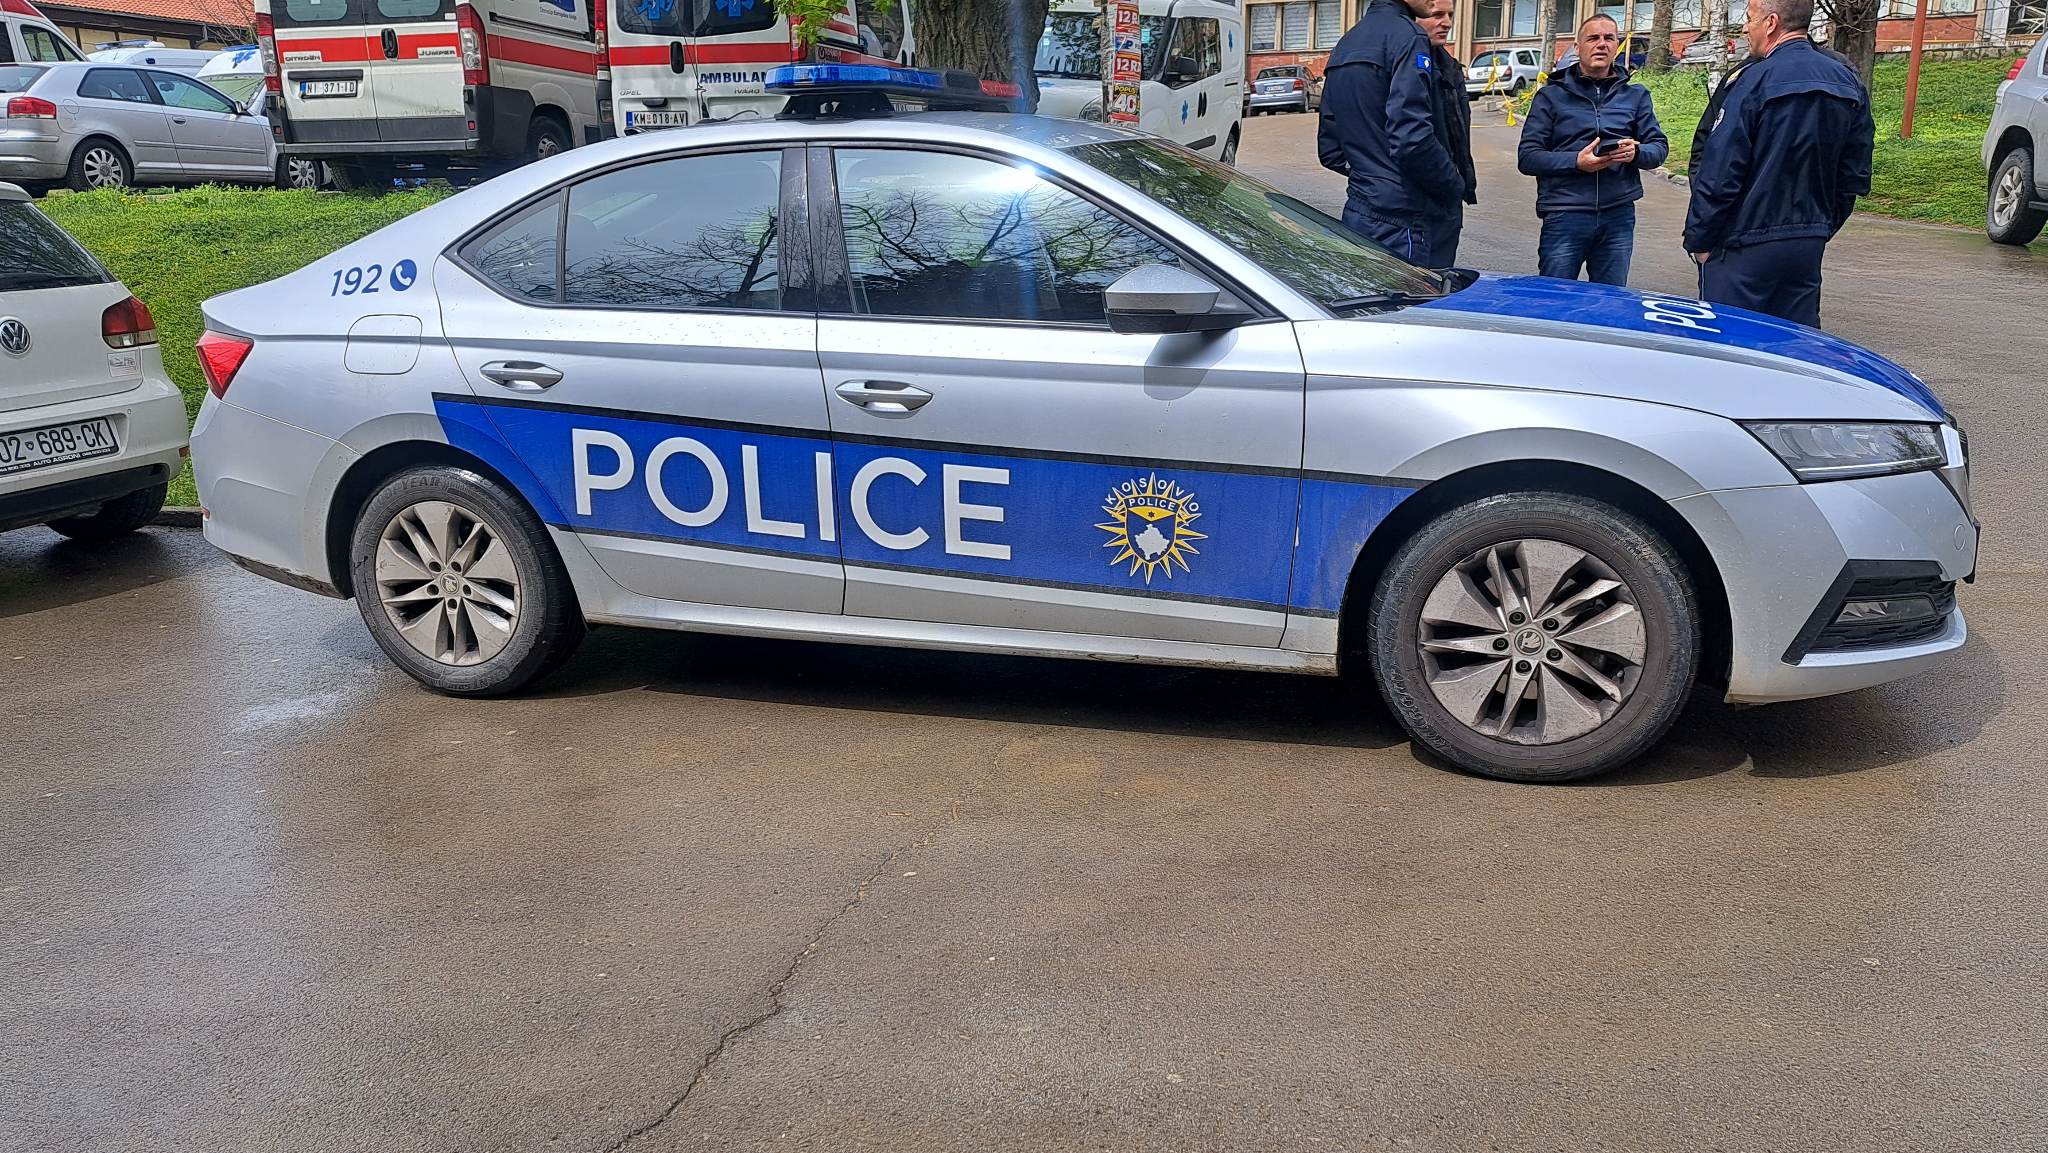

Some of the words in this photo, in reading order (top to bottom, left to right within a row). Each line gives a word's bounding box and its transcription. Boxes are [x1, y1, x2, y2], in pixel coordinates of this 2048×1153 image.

[634, 112, 646, 125] KM
[331, 264, 383, 297] 192
[33, 457, 52, 467] AUTO
[571, 428, 1011, 561] POLICE
[1105, 477, 1200, 512] KOSOVO
[1128, 497, 1178, 512] POLICE
